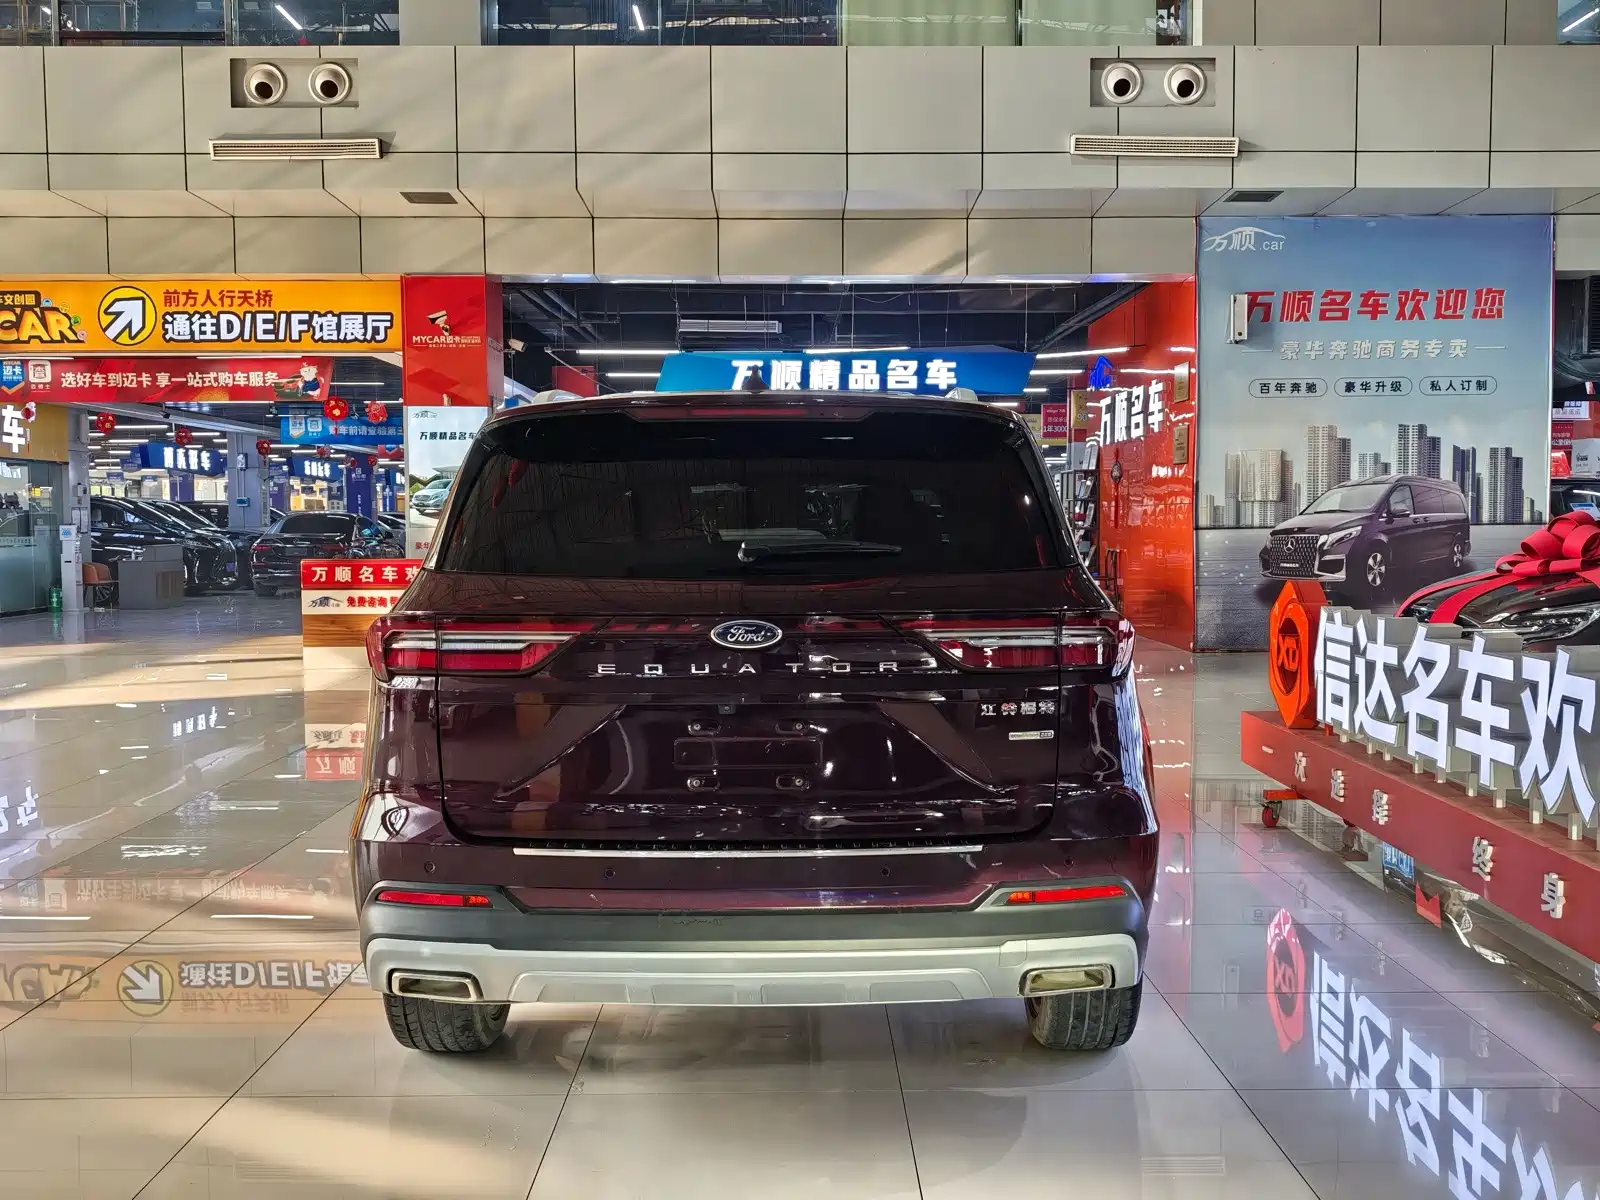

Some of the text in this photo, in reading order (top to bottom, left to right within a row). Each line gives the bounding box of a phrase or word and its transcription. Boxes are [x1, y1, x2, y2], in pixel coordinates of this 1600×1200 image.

[0, 294, 36, 305] 文创园
[163, 289, 273, 307] 前方人行天桥
[1246, 288, 1506, 323] 万顺名车欢迎您
[164, 313, 391, 342] 通往D/E/F馆展厅
[1280, 338, 1468, 361] 豪华奔驰商务专卖
[3, 365, 22, 375] 迈卡
[61, 372, 152, 388] 选好车到迈卡
[156, 371, 279, 388] 享一站式购车服务
[731, 359, 957, 390] 万顺精品名车
[1259, 379, 1488, 394] 百年奔驰 豪华升级 私人订制
[1100, 379, 1164, 447] 万顺名车
[2, 404, 26, 453] 车
[419, 431, 477, 440] 万顺精品名车
[727, 626, 765, 641] Ford
[1277, 635, 1299, 672] XD
[597, 662, 899, 675] EQUATOR
[1314, 606, 1596, 827] 信达名车欢
